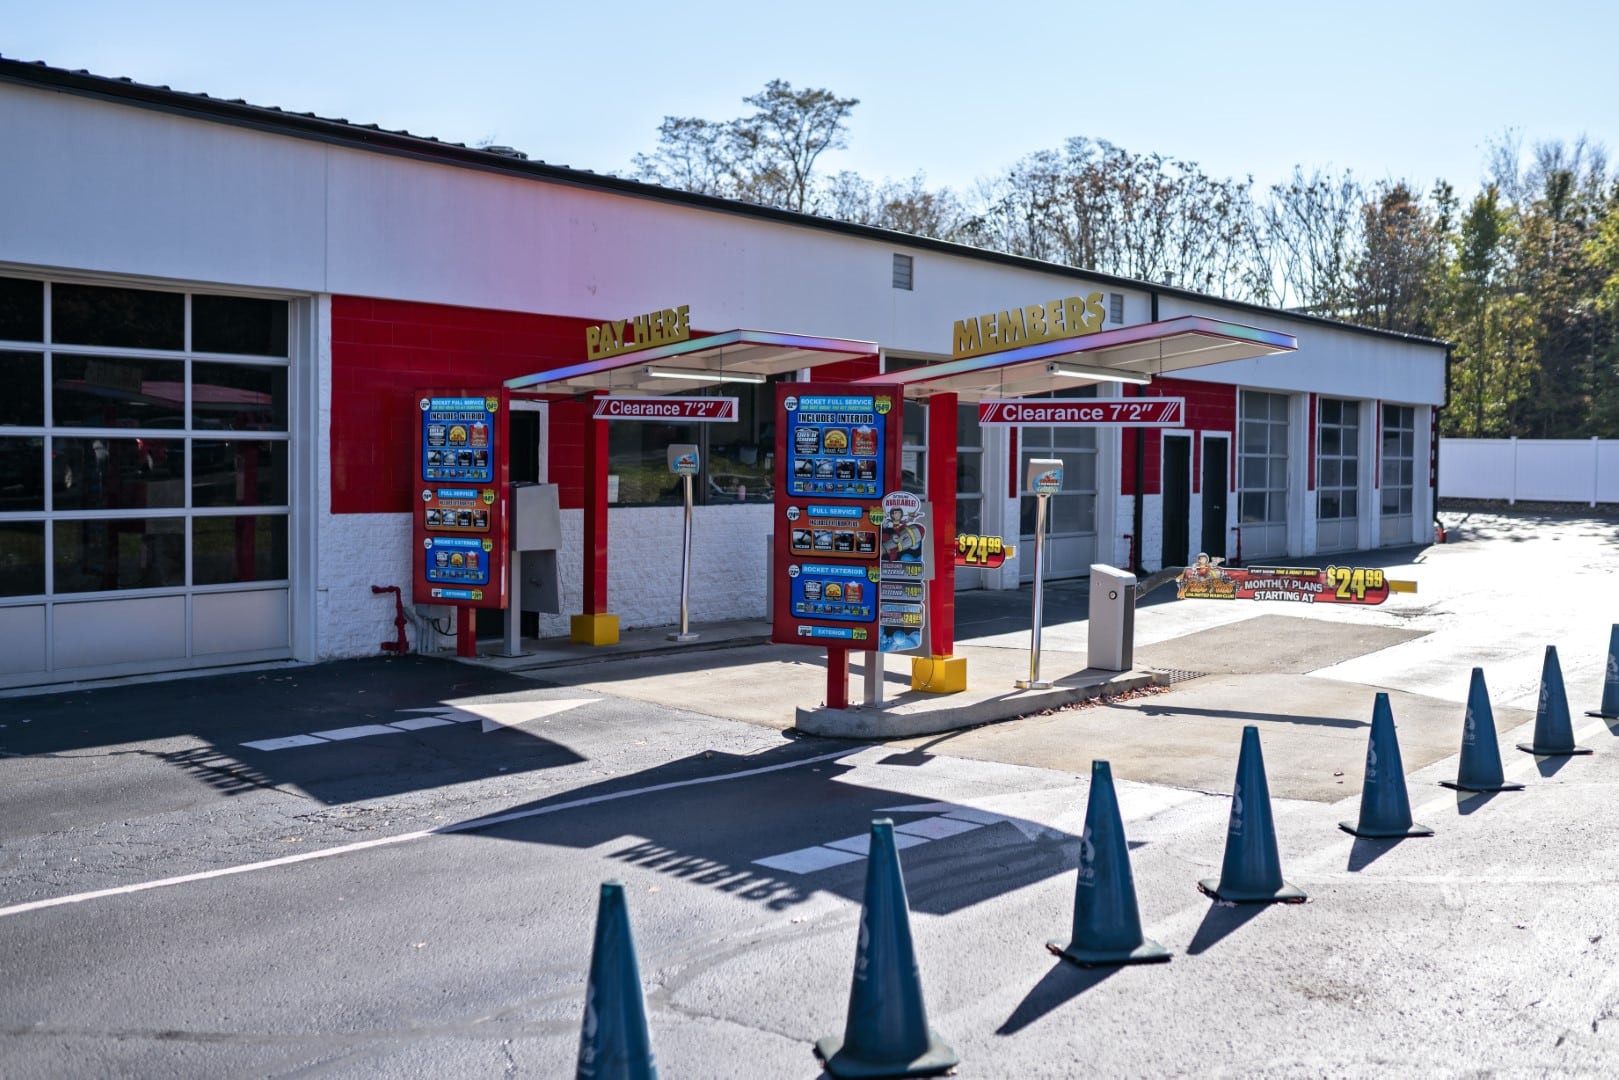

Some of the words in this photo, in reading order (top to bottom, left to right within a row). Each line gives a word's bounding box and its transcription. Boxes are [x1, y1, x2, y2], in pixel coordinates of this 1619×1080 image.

[586, 318, 628, 357] PAY
[633, 304, 691, 348] HERE
[952, 292, 1106, 357] MEMBERS
[609, 400, 680, 415] Clearance
[1002, 403, 1104, 421] Clearance
[430, 411, 458, 421] INCLUDES
[798, 413, 835, 423] INCLUDES
[837, 413, 874, 424] INTERIOR
[1244, 578, 1289, 591] MONTHLY
[1291, 579, 1323, 592] PLANS
[1254, 591, 1299, 602] STARTING
[1301, 592, 1315, 603] AT
